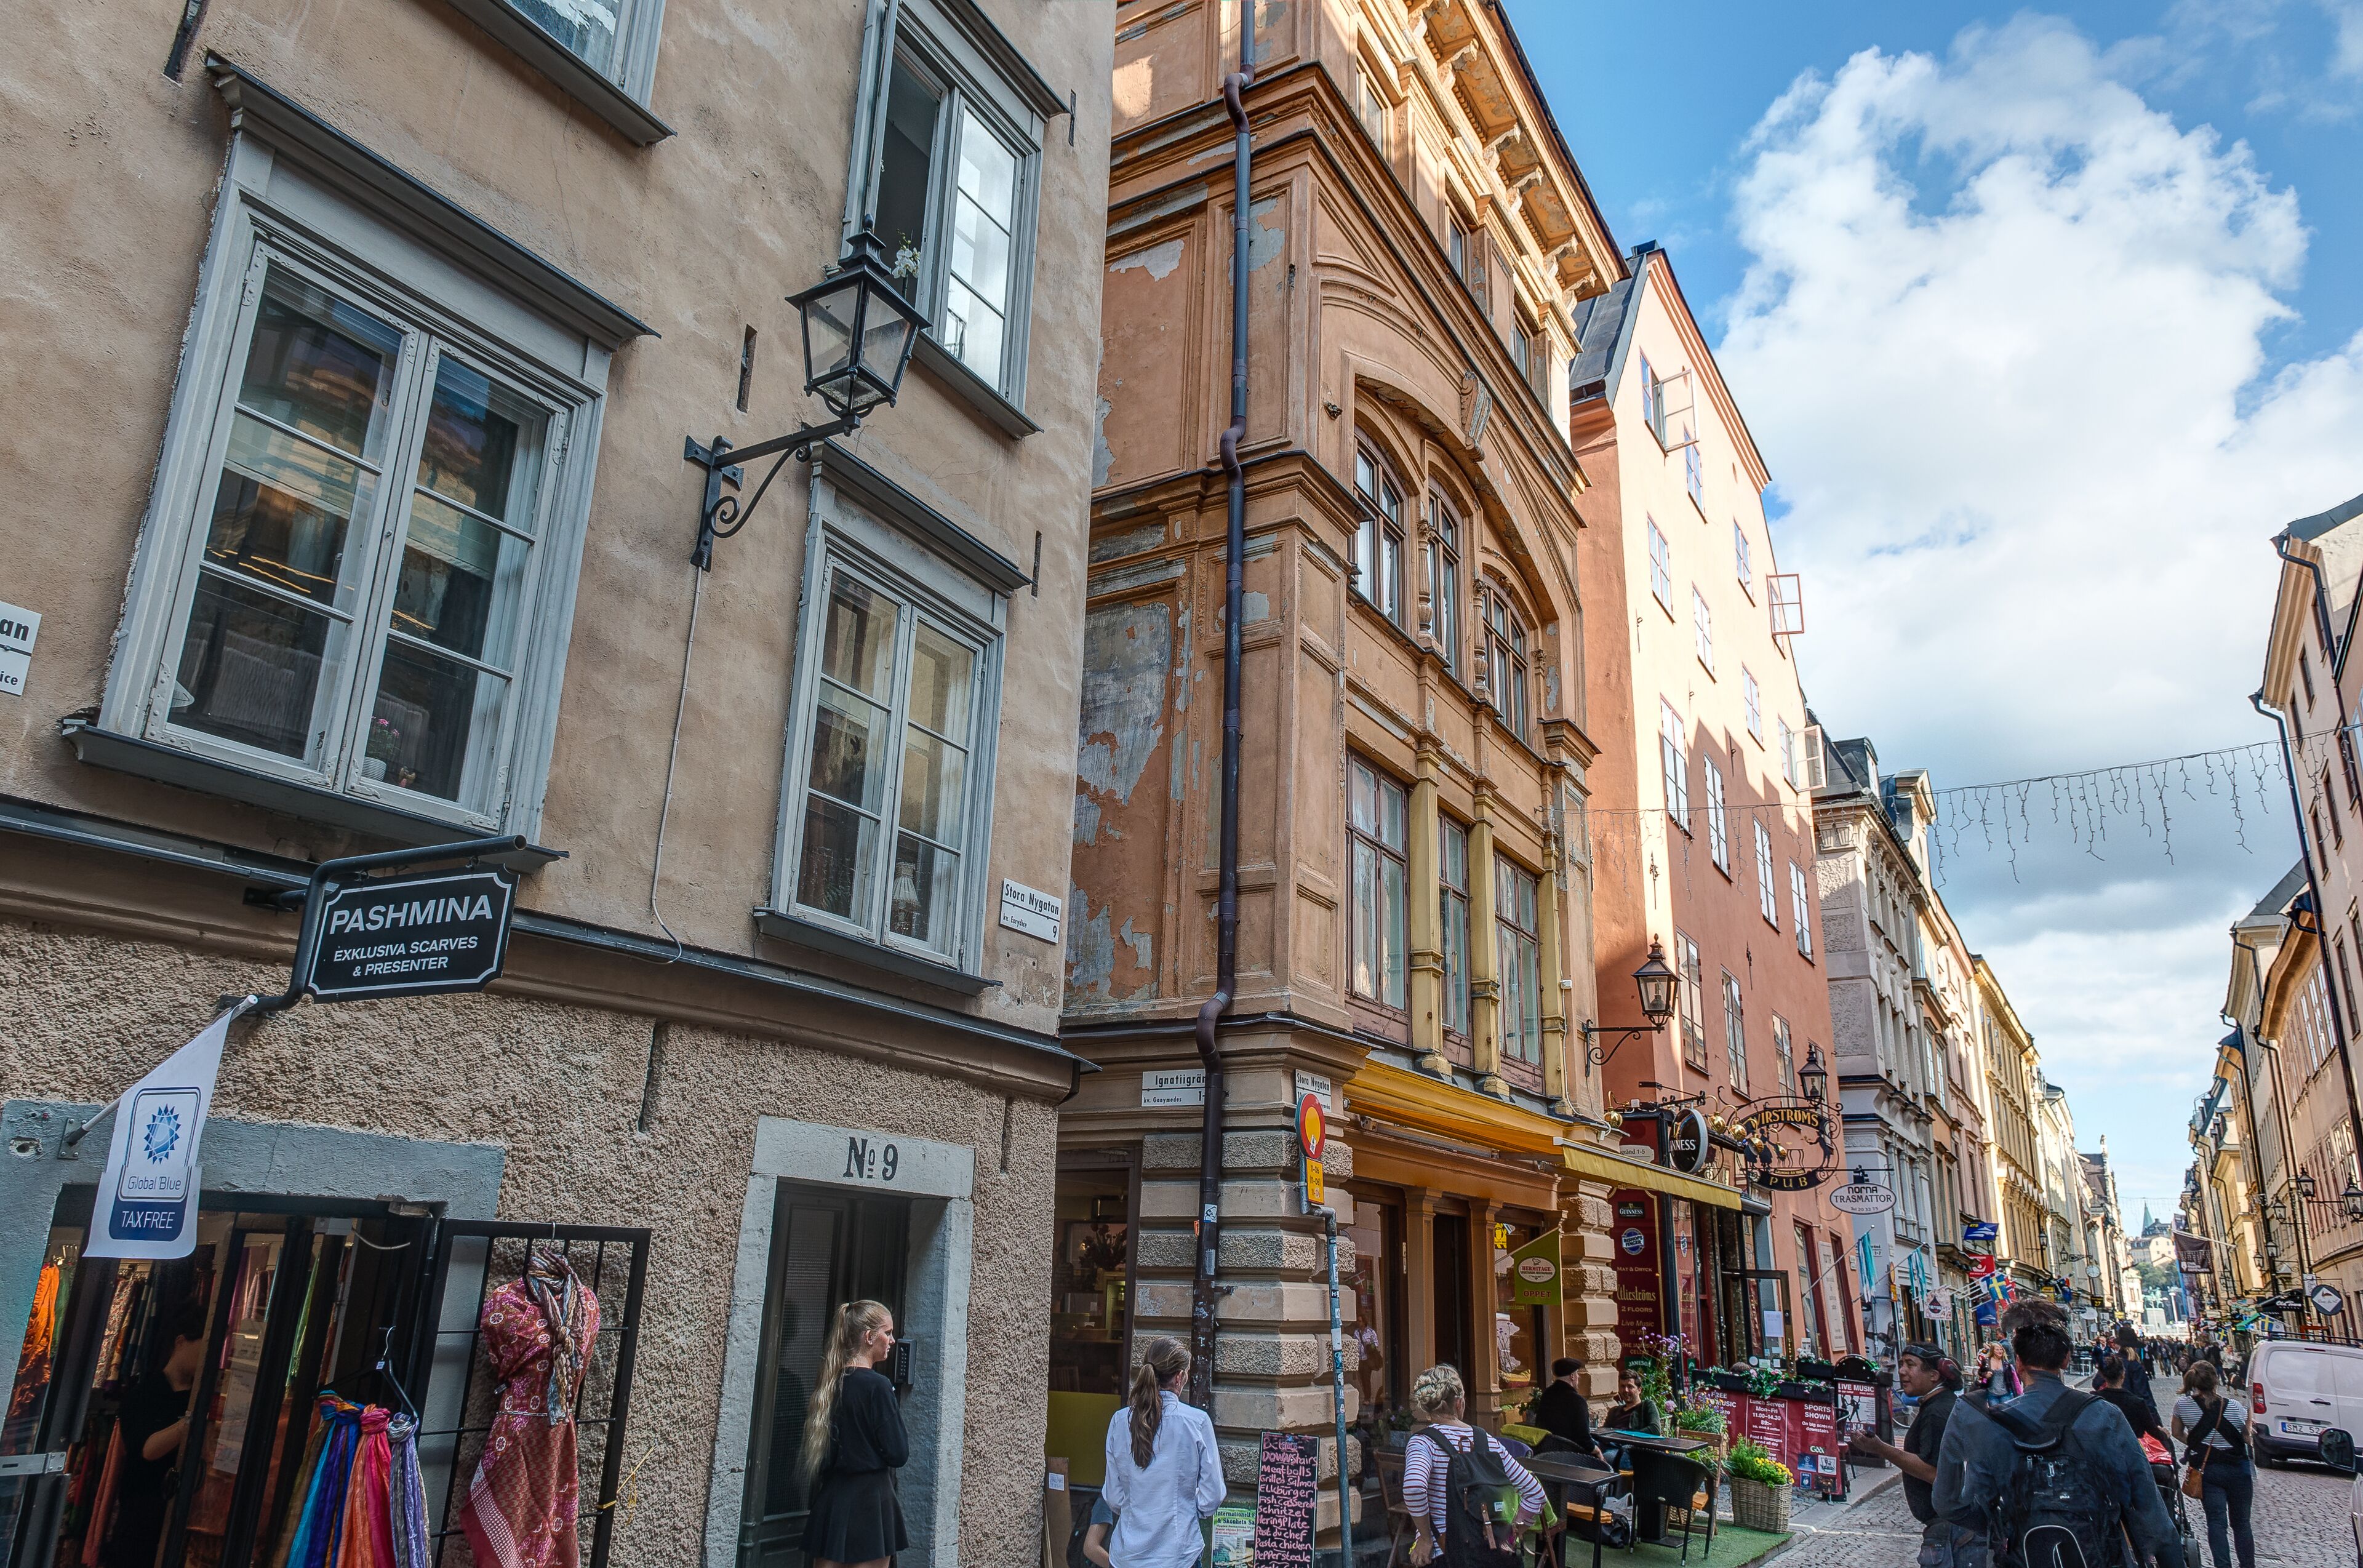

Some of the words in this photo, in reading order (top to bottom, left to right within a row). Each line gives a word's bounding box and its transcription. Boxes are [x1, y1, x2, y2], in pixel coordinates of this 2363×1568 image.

[1005, 884, 1025, 902] Stora
[1029, 892, 1059, 915] Nygatan
[329, 895, 493, 935] PASHMINA
[1011, 916, 1027, 928] Eurydice
[1052, 925, 1057, 938] 9
[334, 943, 406, 962] EXKLUSIVA
[409, 936, 479, 954] SCARVES
[353, 966, 362, 977] &
[364, 956, 449, 976] PRESENTER
[1297, 1073, 1309, 1086] Stora
[1311, 1076, 1330, 1091] Nygatan
[1153, 1096, 1182, 1104] Ganymedes
[882, 1143, 898, 1181] 9
[127, 1176, 158, 1190] Global
[159, 1176, 182, 1190] Blue
[1769, 1177, 1808, 1188] PUB
[1834, 1194, 1893, 1203] TRASMATTOR
[1804, 1404, 1831, 1413] SPORTS
[1804, 1412, 1831, 1420] SHOWN
[2287, 1424, 2303, 1433] SMZ
[2309, 1426, 2324, 1434] 52
[1287, 1476, 1318, 1490] Salmon
[1256, 1538, 1277, 1548] Pasta
